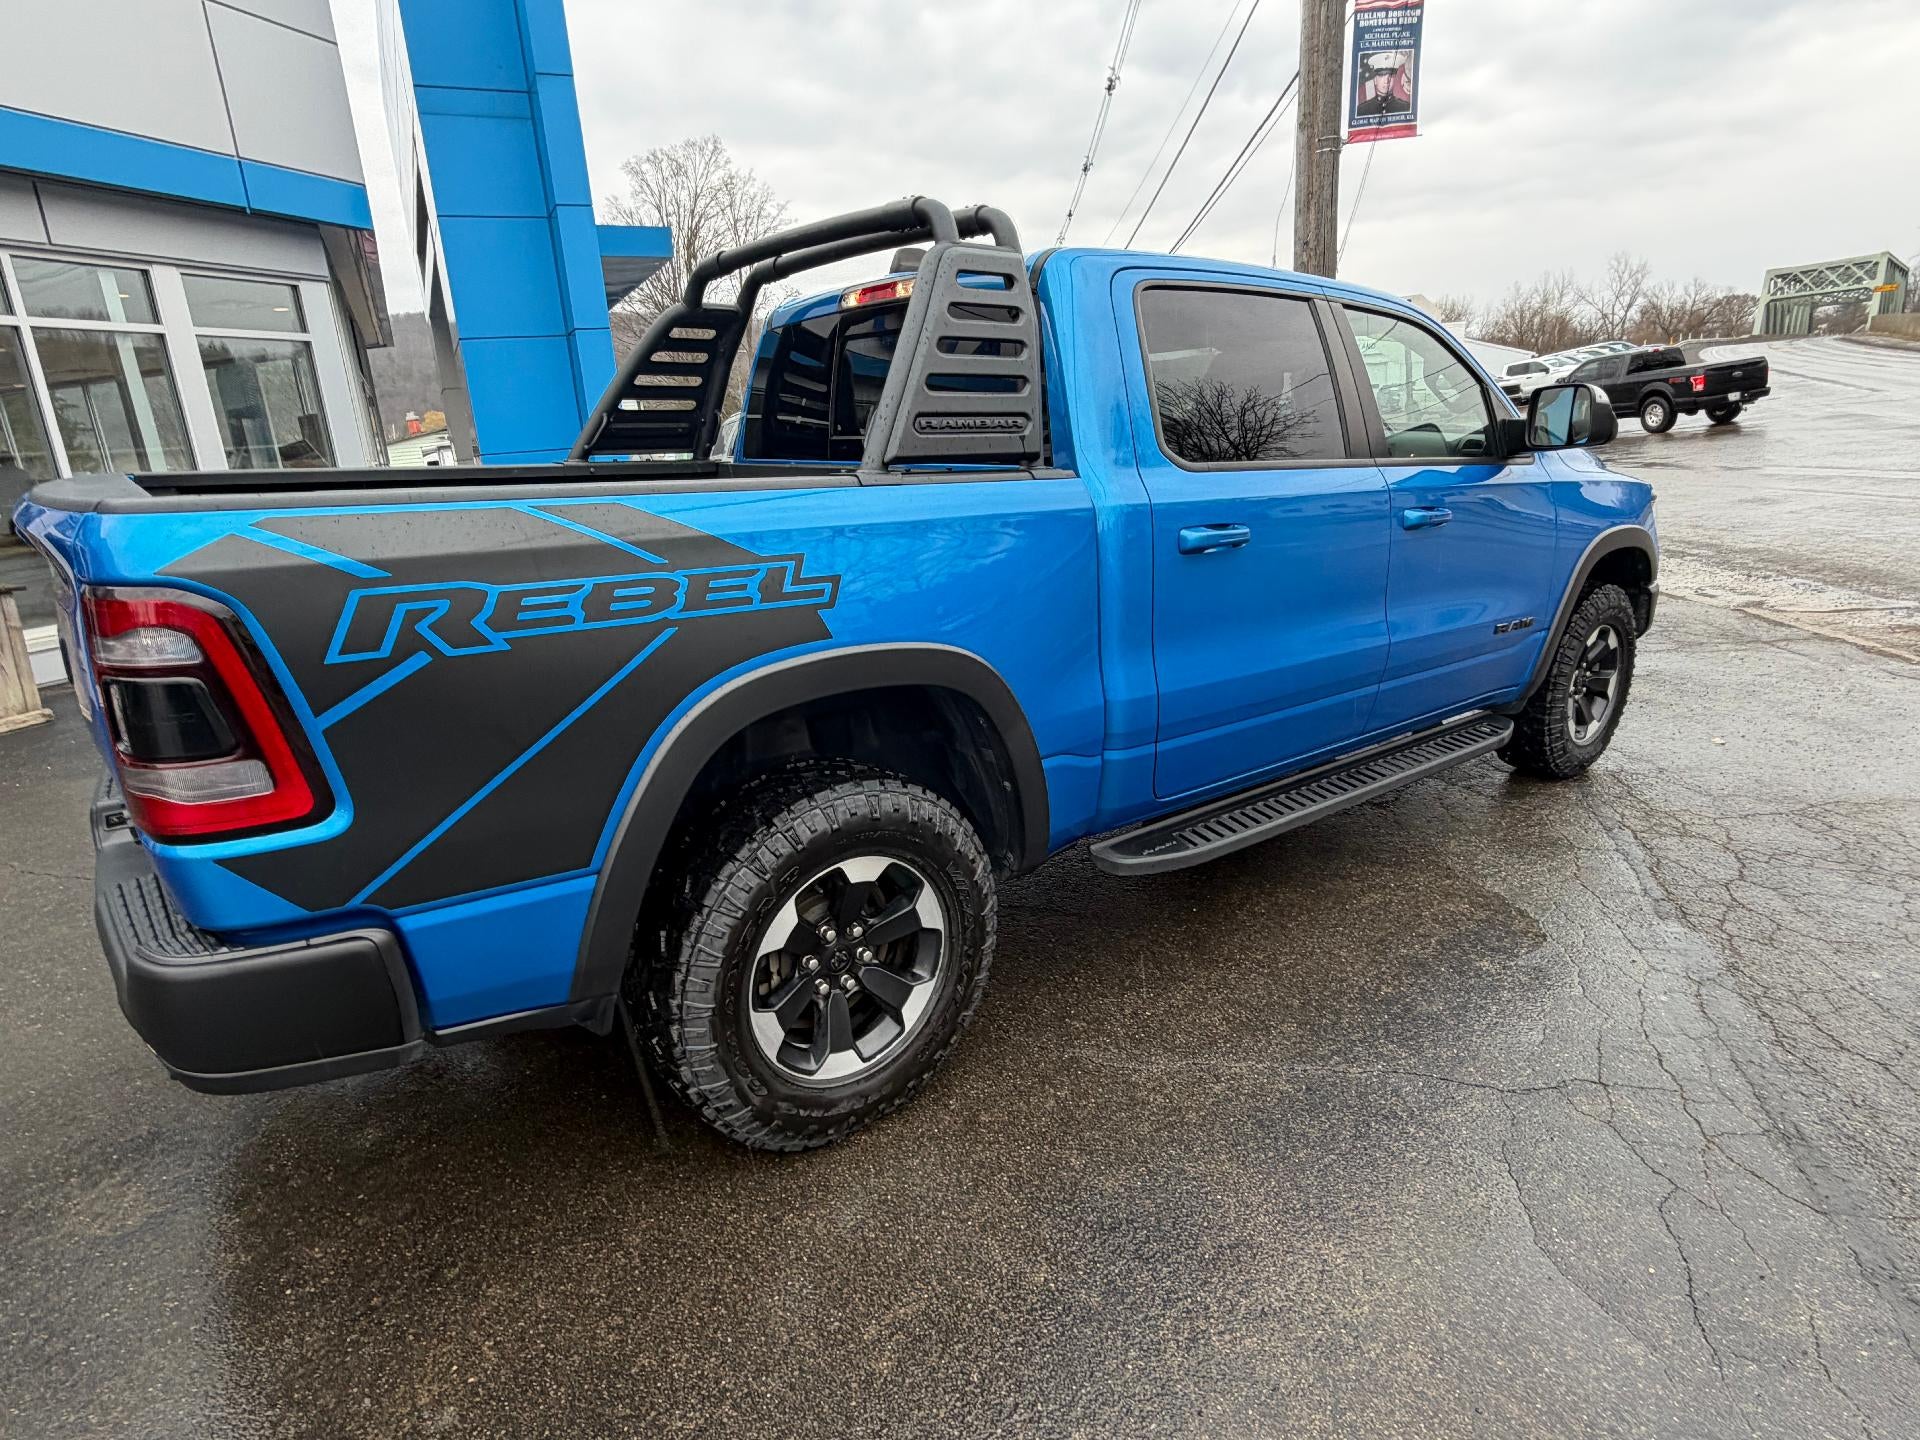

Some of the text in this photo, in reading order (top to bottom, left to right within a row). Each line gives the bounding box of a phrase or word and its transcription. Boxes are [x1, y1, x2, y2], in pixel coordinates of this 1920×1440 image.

[919, 418, 1024, 430] RAMBAR
[324, 557, 838, 664] REBEL
[1493, 616, 1536, 634] RAM
